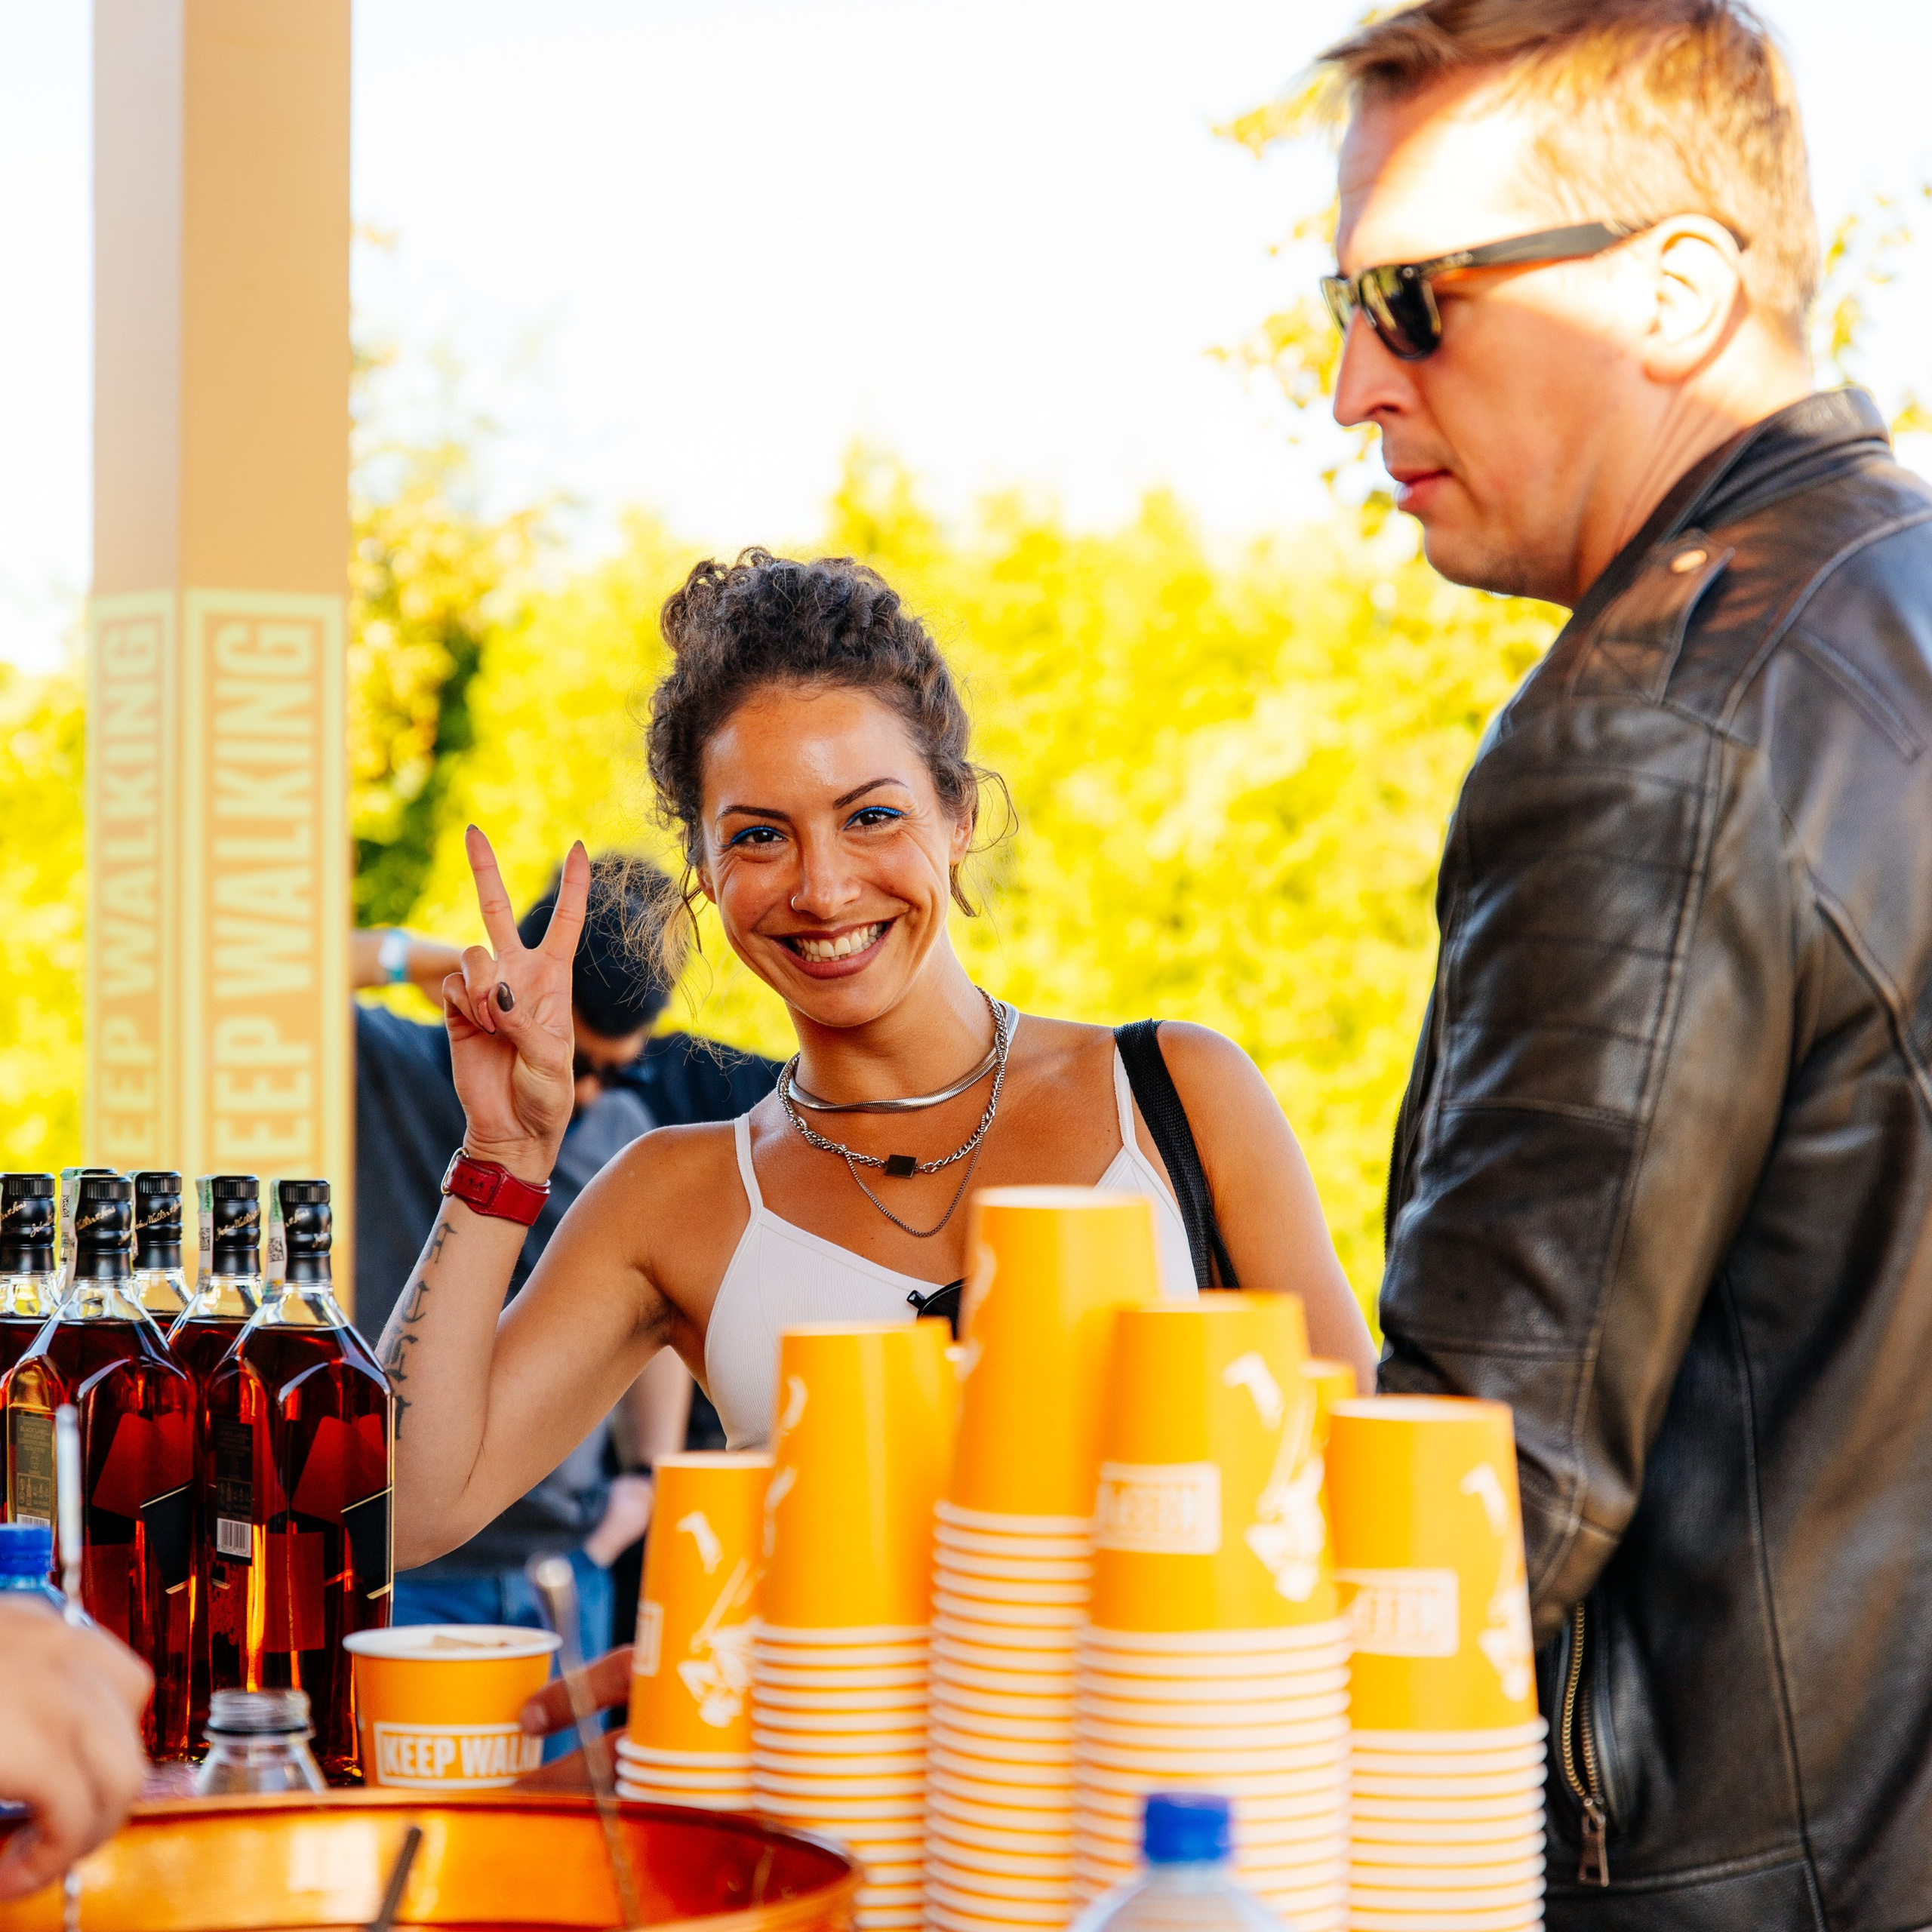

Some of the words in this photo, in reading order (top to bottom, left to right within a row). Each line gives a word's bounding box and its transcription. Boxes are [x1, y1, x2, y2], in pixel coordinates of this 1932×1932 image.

[103, 623, 157, 998] WALKING
[215, 622, 313, 999] WALKING
[102, 1016, 155, 1158] EEP
[215, 1016, 312, 1179] EEP
[382, 1736, 456, 1777] KEEP
